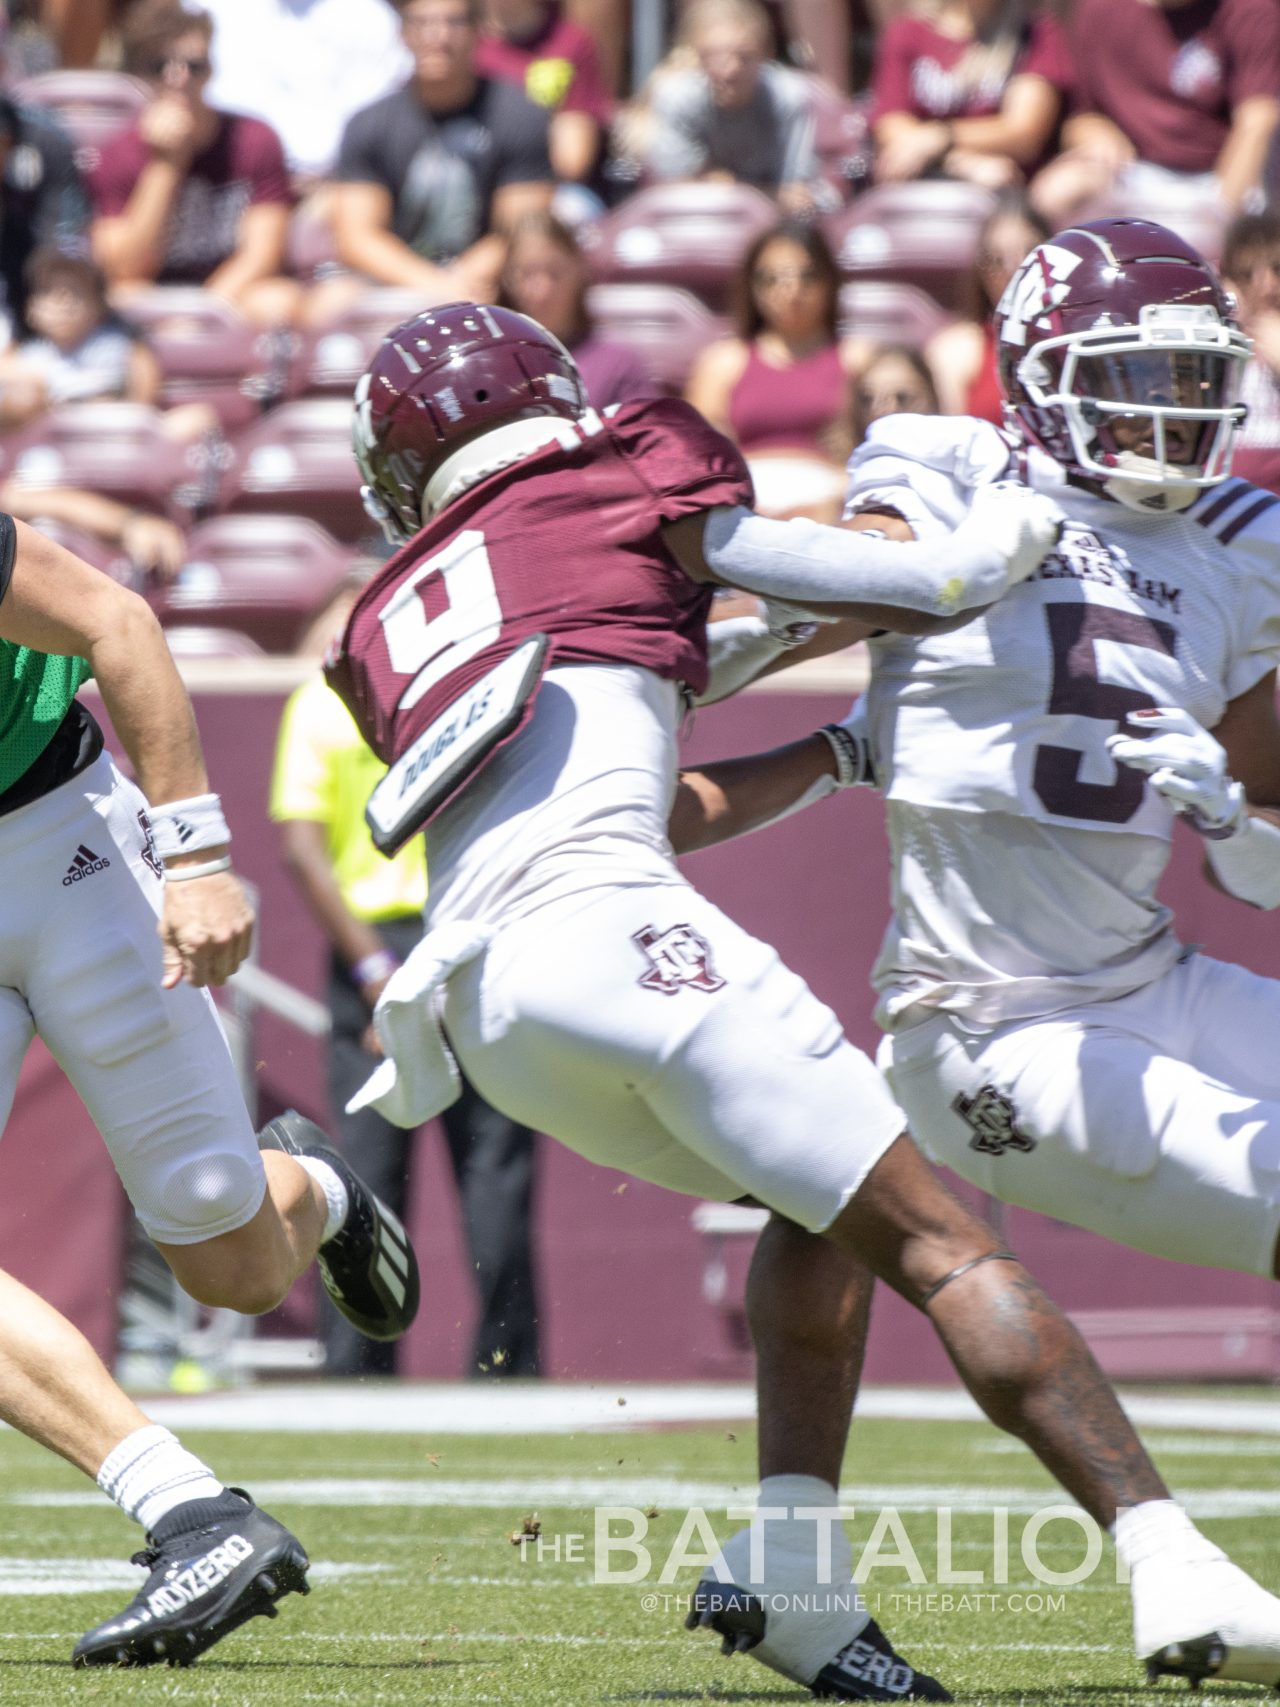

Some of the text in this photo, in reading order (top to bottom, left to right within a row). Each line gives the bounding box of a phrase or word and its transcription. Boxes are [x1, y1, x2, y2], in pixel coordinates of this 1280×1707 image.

[1032, 602, 1177, 824] 5
[62, 857, 111, 887] adidas
[147, 1534, 255, 1618] ADIZERO
